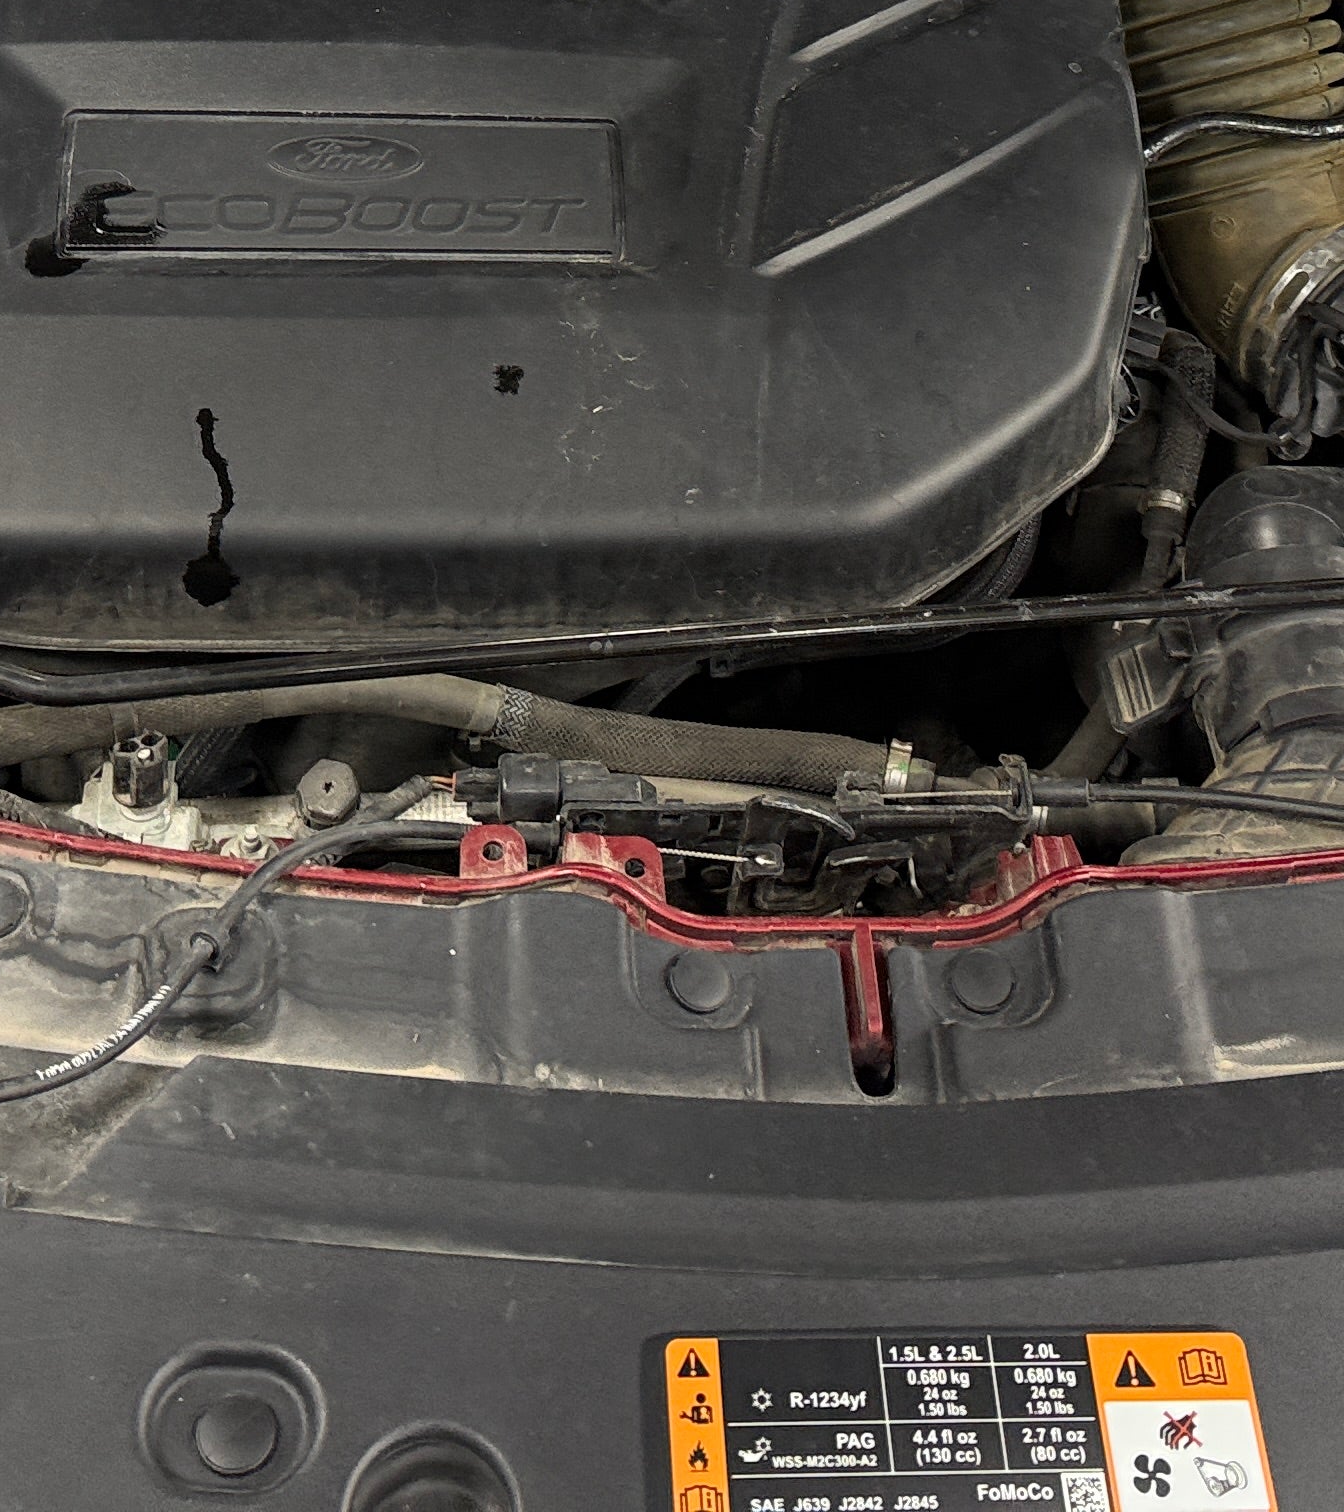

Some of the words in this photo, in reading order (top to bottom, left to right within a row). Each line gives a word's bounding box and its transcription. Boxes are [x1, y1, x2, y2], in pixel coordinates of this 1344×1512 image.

[293, 137, 395, 172] Ford
[889, 1346, 925, 1362] 1.5L
[929, 1346, 942, 1361] &
[946, 1345, 983, 1361] 2.5L
[1023, 1344, 1060, 1360] 2.0L
[907, 1369, 947, 1385] 0.680
[951, 1369, 970, 1388] kg
[1014, 1368, 1053, 1383] 0.680
[1057, 1368, 1077, 1386] kg
[924, 1388, 939, 1401] 24
[942, 1390, 958, 1401] oz
[1031, 1386, 1046, 1399] 24
[1049, 1388, 1065, 1399] oz
[789, 1391, 867, 1411] R-1234yf
[1026, 1402, 1052, 1415] 1.50
[1055, 1401, 1074, 1414] lbs
[918, 1403, 945, 1416] 1.50
[947, 1403, 967, 1416] lbs
[836, 1433, 875, 1449] PAG
[913, 1430, 938, 1444] 4.4
[941, 1429, 954, 1444] fl
[957, 1432, 978, 1444] oz
[1022, 1428, 1047, 1443] 2.7
[1050, 1427, 1063, 1442] fl
[1066, 1430, 1087, 1442] oz
[772, 1455, 878, 1468] WSS-M2C300-A2
[916, 1448, 951, 1466] (130
[955, 1447, 981, 1465] cc)
[1031, 1447, 1056, 1464] (80
[1061, 1446, 1086, 1463] cc)
[977, 1484, 1054, 1501] FoMoCo
[750, 1498, 785, 1512] SAE
[792, 1497, 830, 1512] J639
[839, 1496, 883, 1511] J2842
[894, 1495, 939, 1510] J2845
